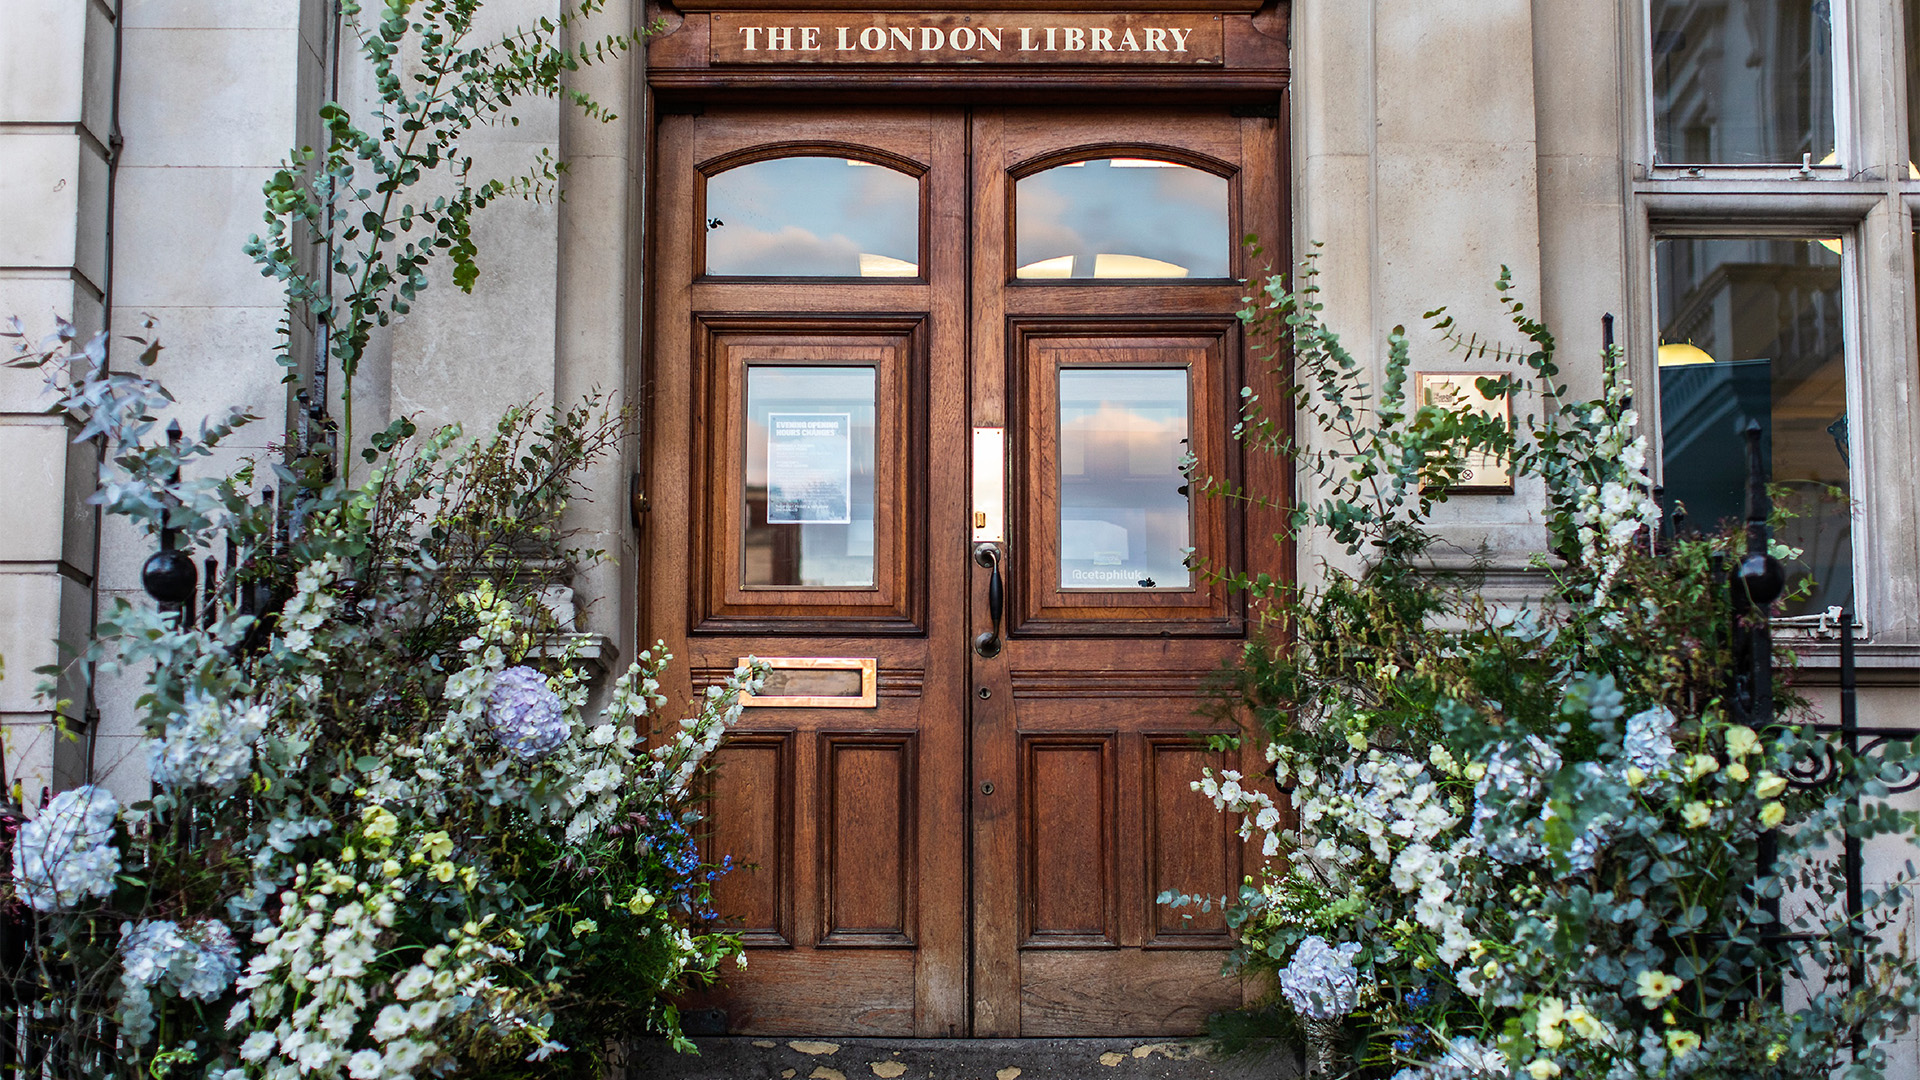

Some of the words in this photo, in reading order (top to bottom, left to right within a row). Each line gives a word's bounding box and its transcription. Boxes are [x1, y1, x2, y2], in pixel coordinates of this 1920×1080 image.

[739, 26, 822, 51] THE
[835, 26, 1004, 51] LONDON
[1017, 26, 1193, 52] LIBRARY
[776, 421, 806, 429] EVENING
[807, 421, 839, 429] OPENING
[1072, 569, 1142, 582] @cetaphiluk
